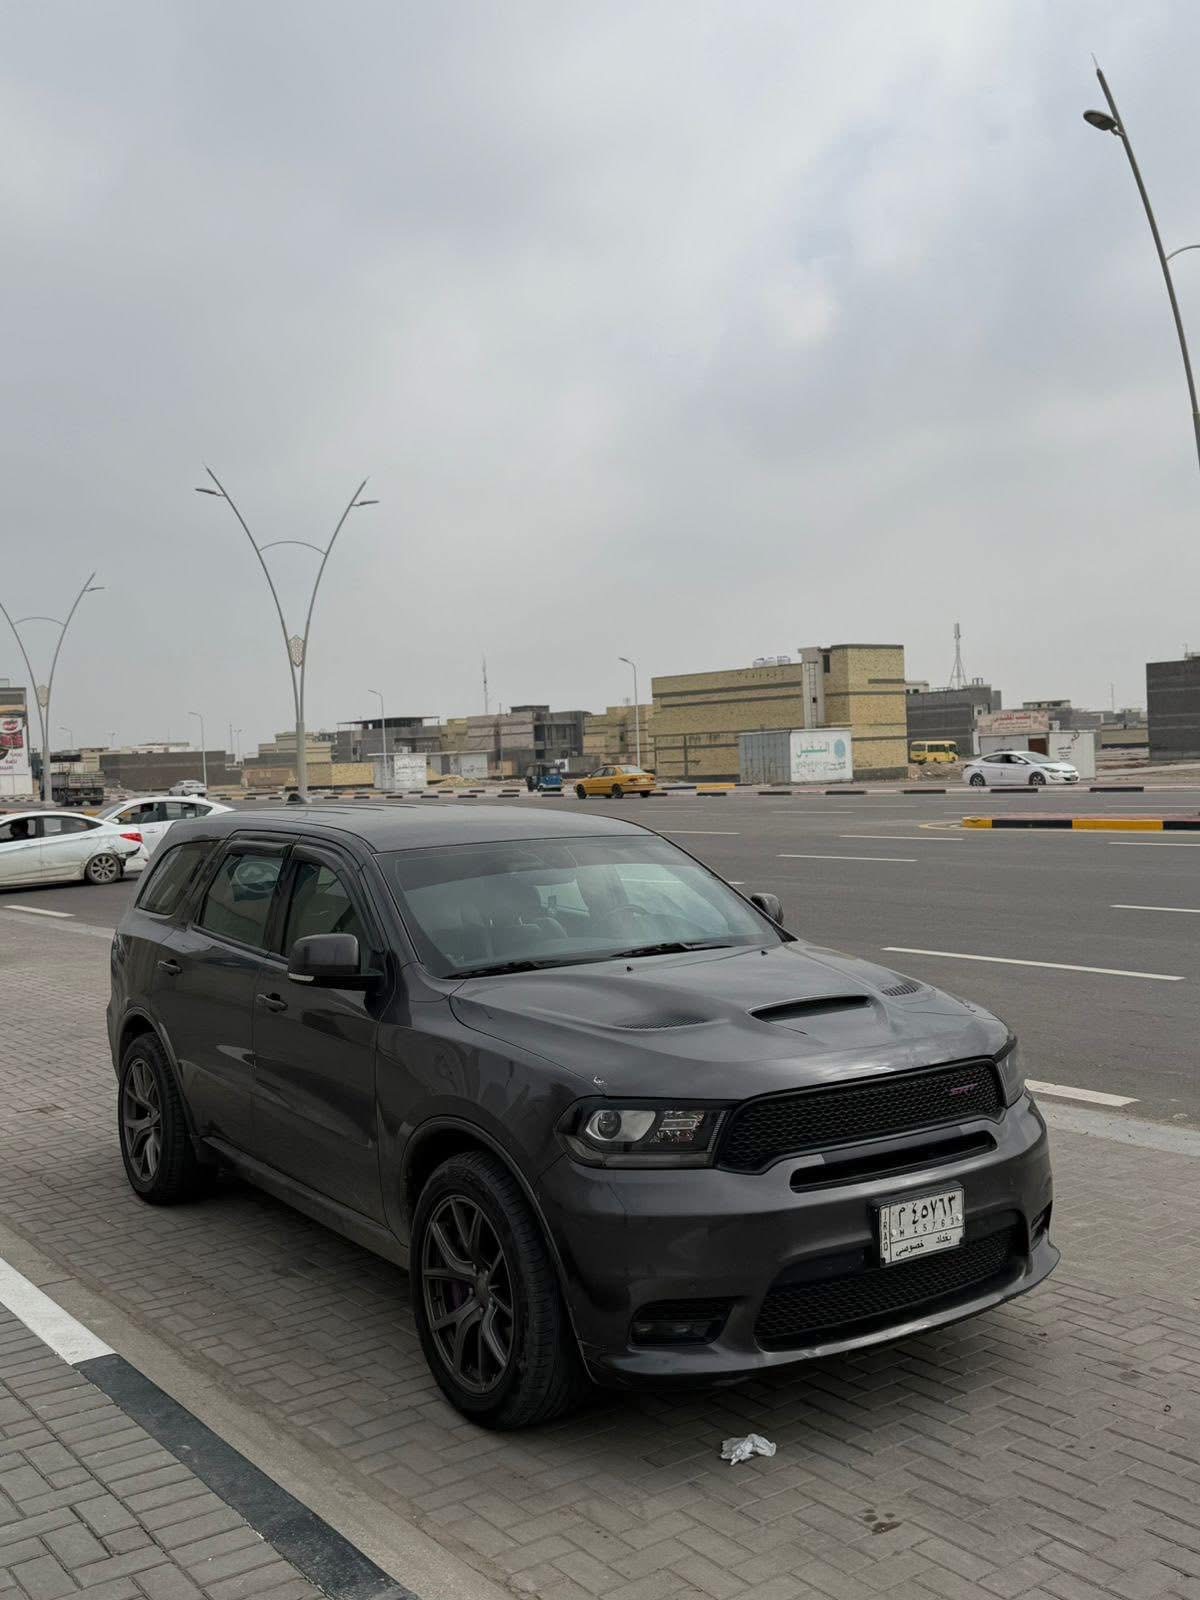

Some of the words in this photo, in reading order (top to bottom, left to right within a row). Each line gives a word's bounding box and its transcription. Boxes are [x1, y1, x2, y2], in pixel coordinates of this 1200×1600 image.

[912, 1194, 956, 1225] ٤٥٧٦٣
[935, 1231, 952, 1244] بغداد
[896, 1239, 925, 1256] خصوصي
